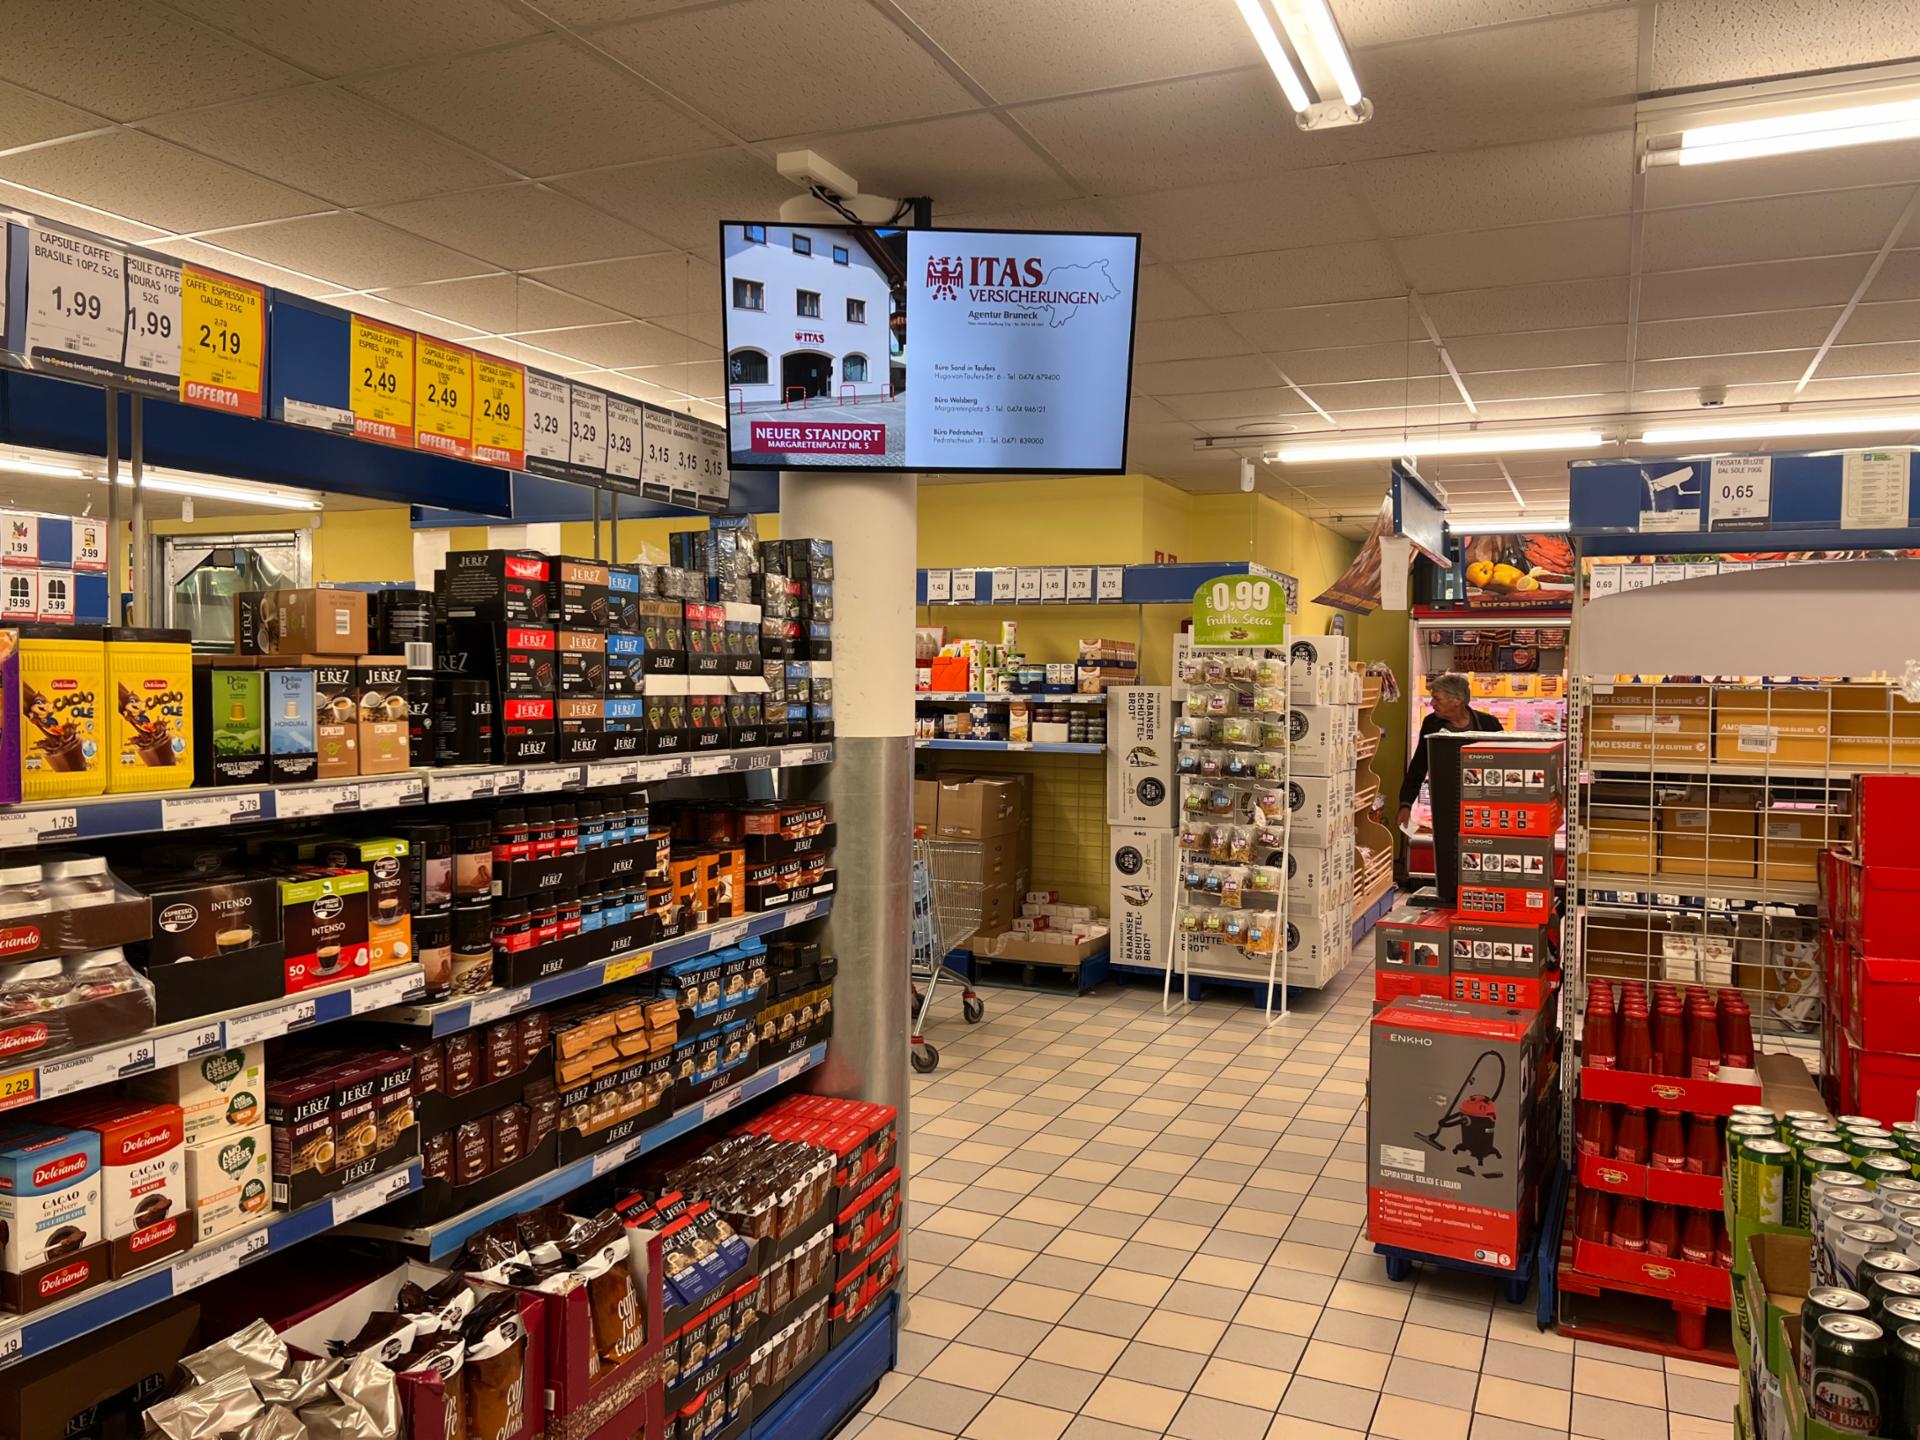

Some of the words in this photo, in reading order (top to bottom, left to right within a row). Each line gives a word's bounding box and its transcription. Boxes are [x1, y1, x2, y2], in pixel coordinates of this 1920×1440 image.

[40, 232, 81, 251] CAPSULE
[34, 245, 73, 265] BRASILE
[76, 258, 99, 274] 10PZ
[101, 265, 119, 279] 52G
[969, 257, 1044, 288] ITAS
[52, 286, 101, 319] 1,99
[142, 292, 159, 304] 52G
[200, 294, 224, 309] CIALDE
[225, 303, 243, 313] 125G
[211, 287, 246, 304] ESPRESSO
[968, 289, 1100, 304] VERSICHERUNGEN
[128, 306, 171, 338] 1,99
[968, 310, 1002, 321] Agentur
[1003, 310, 1038, 320] Bruneck
[199, 324, 241, 354] 2,19
[360, 329, 384, 343] CAPSULE
[804, 332, 825, 344] ITAS
[364, 367, 397, 393] 2,49
[187, 383, 239, 407] OFFERTA
[427, 384, 457, 408] 2,49
[949, 396, 978, 405] Welsberg
[484, 399, 510, 421] 2,49
[356, 419, 396, 439] OFFERTA
[533, 412, 559, 434] 3,29
[573, 421, 596, 442] 3,29
[755, 427, 801, 440] NEUER
[804, 428, 882, 441] STANDORT
[933, 428, 948, 436] Büro
[420, 432, 457, 451] OFFERTA
[610, 433, 632, 453] 3,29
[768, 440, 847, 449] MARGARETENPLATZ
[864, 442, 869, 450] 5
[477, 446, 511, 463] OFFERTA
[649, 444, 670, 463] 3,15
[678, 451, 698, 470] 3,15
[704, 459, 722, 476] 3,15
[1716, 458, 1742, 466] PASSATA
[1722, 485, 1754, 500] 0,65
[458, 554, 489, 568] JEREZ
[1242, 614, 1273, 626] Secca
[518, 633, 547, 648] JEREZ
[569, 636, 598, 650] JEREZ
[614, 638, 638, 652] JEREZ
[366, 669, 402, 685] JEREZ
[53, 691, 95, 712] CACAO
[145, 691, 184, 710] CACAO
[515, 703, 545, 718] JEREZ
[569, 703, 598, 717] JEREZ
[612, 703, 636, 716] JEREZ
[1137, 692, 1145, 742] SCHÜTTEL-
[1146, 692, 1154, 741] RABANSER
[517, 741, 547, 757] JEREZ
[571, 738, 597, 752] JEREZ
[614, 737, 636, 751] JEREZ
[1611, 741, 1643, 750] ESSERE
[342, 791, 358, 801] 5,79
[239, 800, 257, 811] 5,79
[51, 815, 75, 829] 1,79
[611, 859, 634, 873] JEREZ
[373, 879, 402, 890] INTENSO
[539, 872, 563, 888] JEREZ
[210, 896, 253, 912] INTENSO
[164, 907, 194, 918] ESPRESSO
[175, 912, 194, 921] ITALIA
[311, 922, 346, 936] INTENSO
[1126, 911, 1134, 960] RABANSER
[610, 936, 632, 951] JEREZ
[289, 964, 305, 977] 50
[540, 958, 564, 975] JEREZ
[297, 1006, 315, 1019] 2,79
[197, 1032, 216, 1045] 1,89
[1389, 1034, 1433, 1047] ENKHO
[42, 1064, 60, 1075] CACAO
[60, 1056, 94, 1070] ZUCCHERATO
[127, 1048, 149, 1063] 1,59
[206, 1056, 228, 1072] AMO
[451, 1051, 473, 1064] AROMA
[206, 1059, 240, 1080] ESSERE
[453, 1060, 473, 1072] FORTE
[5, 1078, 30, 1095] 2,29
[380, 1067, 412, 1092] JEREZ
[339, 1081, 374, 1107] JEREZ
[563, 1086, 590, 1108] JEREZ
[293, 1095, 331, 1123] JEREZ
[606, 1122, 635, 1142] JEREZ
[123, 1129, 171, 1153] Dolciando
[464, 1138, 485, 1151] AROMA
[222, 1144, 241, 1160] AMO
[222, 1147, 252, 1170] ESSERE
[465, 1147, 485, 1160] FORTE
[35, 1158, 87, 1184] Dolciando
[129, 1160, 166, 1180] CACAO
[139, 1170, 164, 1185] polvere
[341, 1158, 377, 1185] JEREZ
[1380, 1169, 1414, 1182] ASPIRATORE
[42, 1191, 81, 1211] CACAO
[131, 1222, 176, 1249] Dolciando
[246, 1235, 266, 1252] 5,79
[41, 1265, 89, 1293] Dolciando
